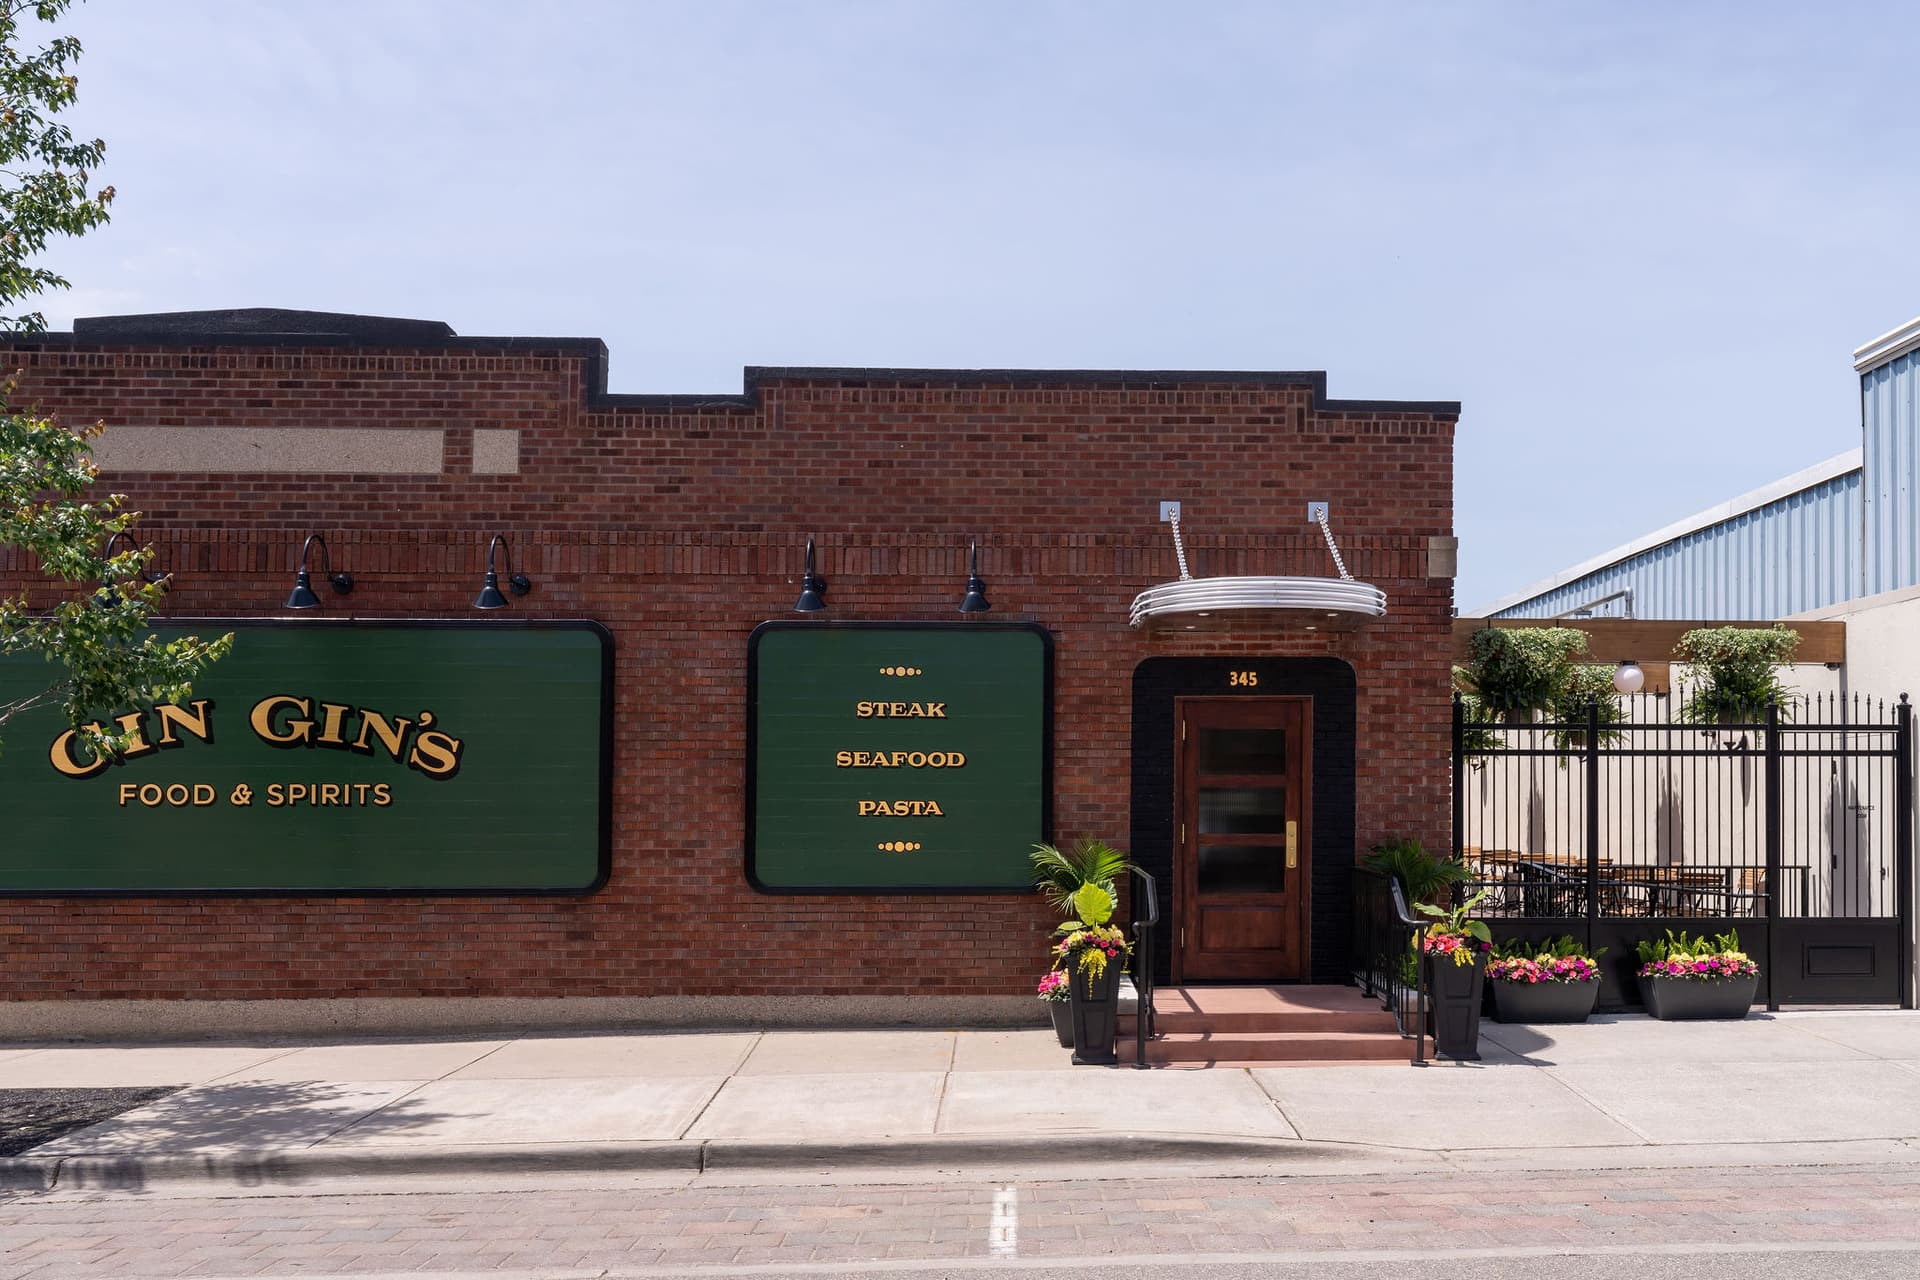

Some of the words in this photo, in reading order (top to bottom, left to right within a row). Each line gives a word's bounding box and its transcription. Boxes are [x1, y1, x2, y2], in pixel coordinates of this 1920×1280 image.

[1229, 671, 1258, 687] 345
[856, 701, 946, 718] STEAK
[50, 700, 209, 776] GIN
[250, 695, 461, 775] GIN'S
[836, 751, 966, 767] SEAFOOD
[119, 783, 216, 806] FOOD
[230, 783, 253, 806] &
[266, 783, 392, 806] SPIRITS
[858, 800, 944, 816] PASTA
